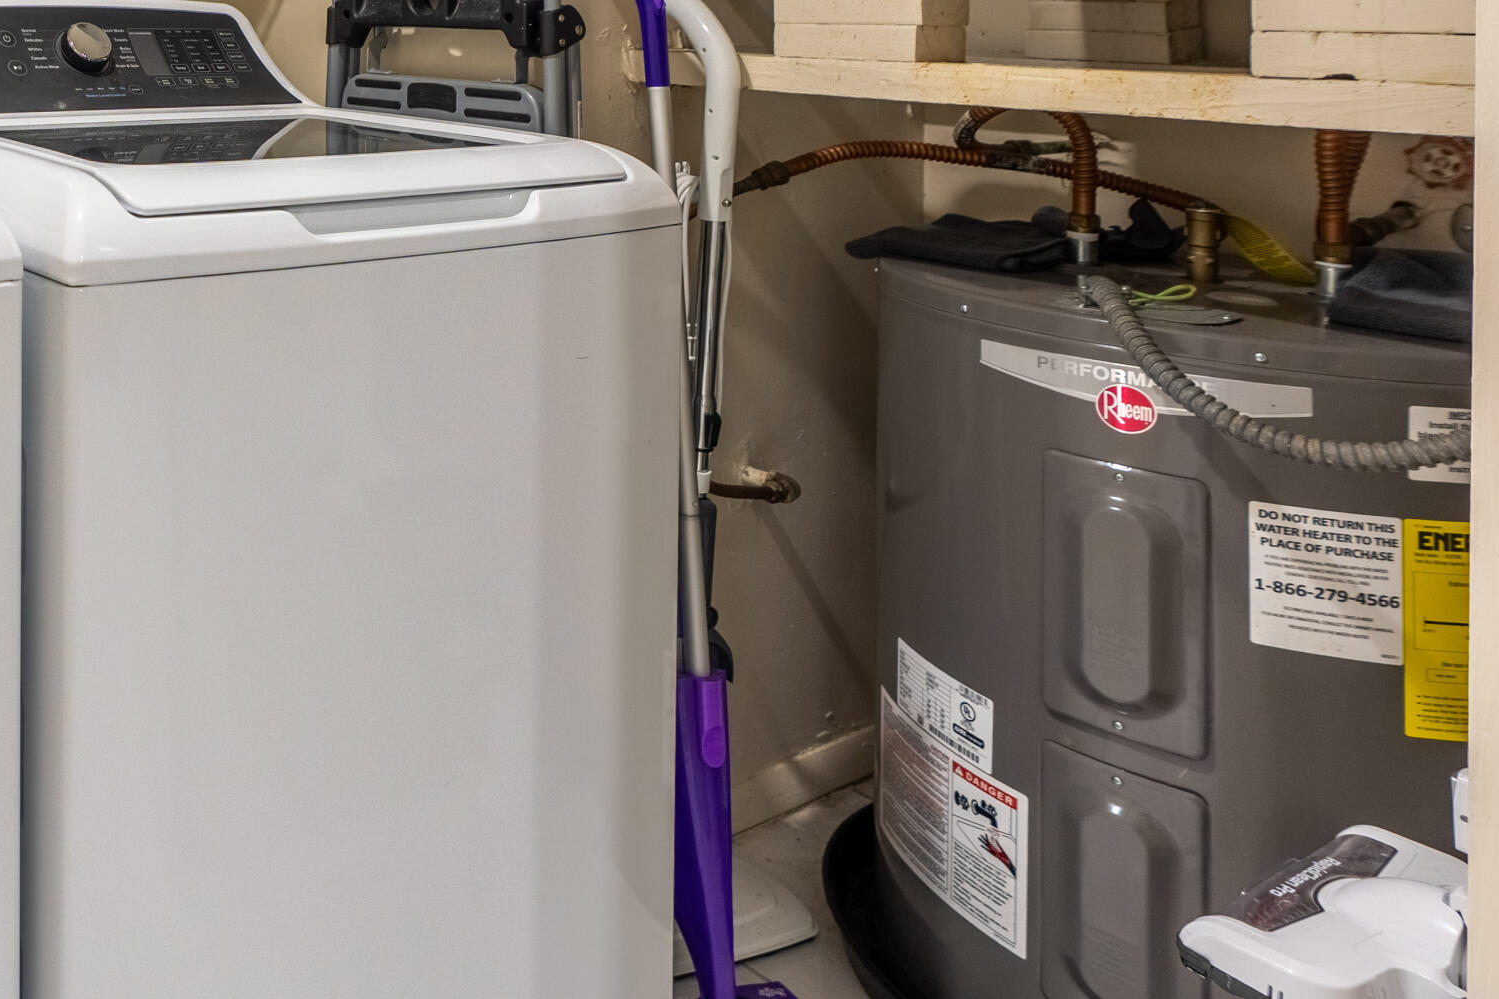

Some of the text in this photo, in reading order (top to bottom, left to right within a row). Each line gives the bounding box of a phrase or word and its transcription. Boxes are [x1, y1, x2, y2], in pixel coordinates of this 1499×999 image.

[1103, 384, 1153, 424] Rheem
[1255, 522, 1399, 548] WATER HEATER TO THE
[1258, 509, 1396, 533] DO NOT RETURN THIS
[1260, 537, 1395, 562] PLACE OF PURCHASE
[1254, 578, 1400, 609] 1-866-279-4566
[965, 772, 1014, 807] DANGER
[1294, 856, 1342, 890] RapidClean
[1269, 883, 1297, 898] Pro
